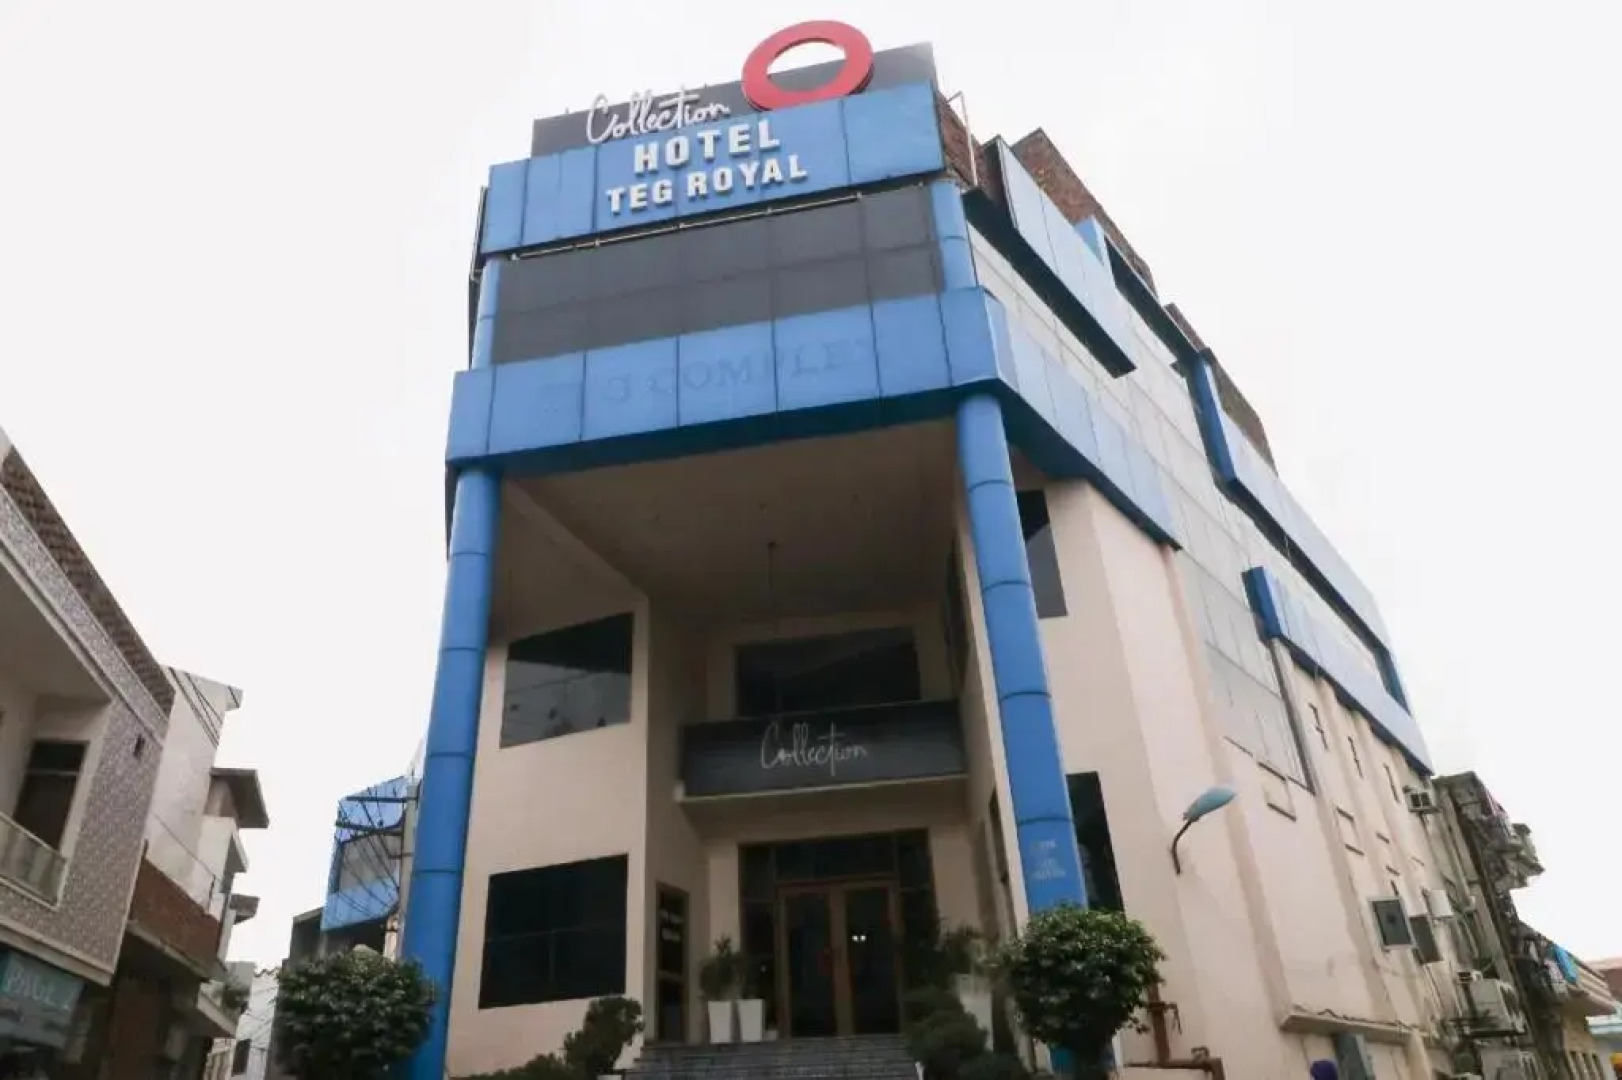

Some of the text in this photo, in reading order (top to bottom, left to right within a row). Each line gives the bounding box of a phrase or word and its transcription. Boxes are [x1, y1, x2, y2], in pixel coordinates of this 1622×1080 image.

[586, 88, 732, 144] Collection
[634, 119, 781, 175] HOTEL
[607, 155, 808, 215] TEG ROYAL
[760, 720, 869, 777] Collection
